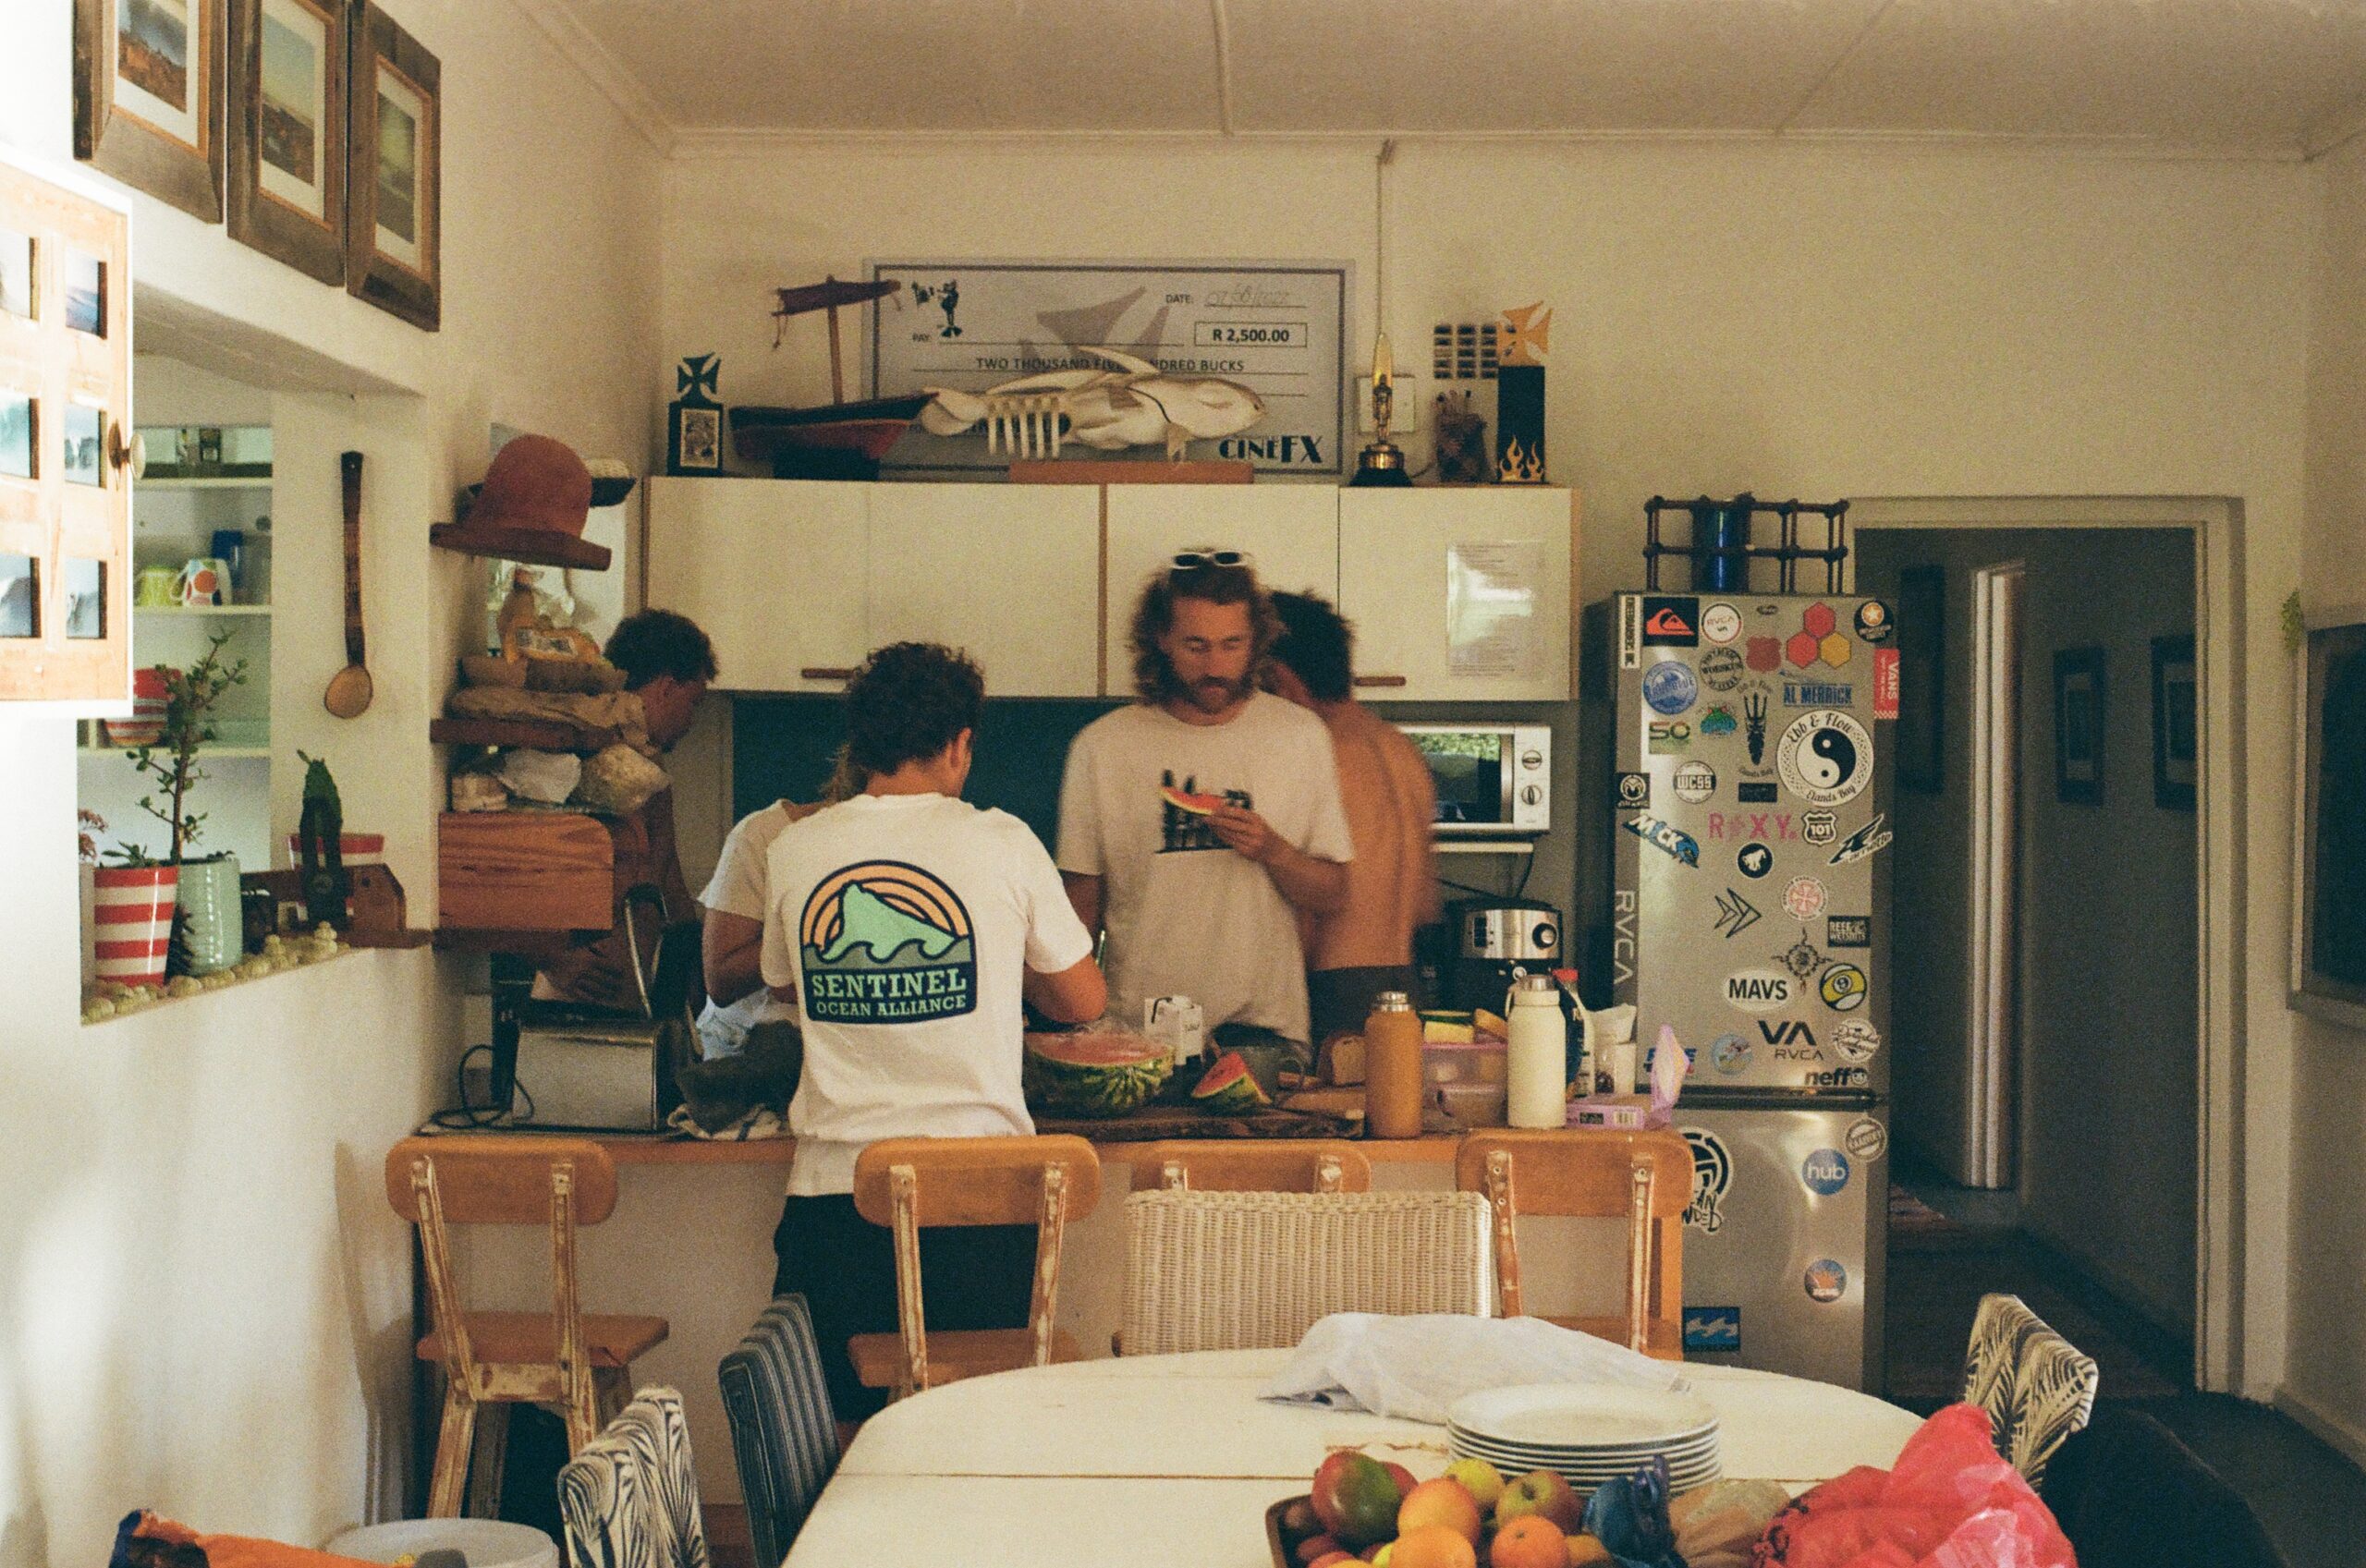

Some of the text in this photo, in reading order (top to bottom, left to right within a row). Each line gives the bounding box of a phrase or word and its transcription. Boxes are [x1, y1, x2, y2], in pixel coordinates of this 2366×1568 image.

[1165, 293, 1194, 304] DATE:
[1212, 328, 1289, 345] R 2,500.00
[976, 358, 1007, 370] TWO
[1014, 358, 1089, 370] THOUSAND
[1201, 359, 1245, 371] BUCKS
[1887, 661, 1899, 700] VANS
[1784, 686, 1796, 704] AL
[1800, 686, 1852, 704] MERRICK
[1787, 722, 1808, 743] Ebb
[1810, 713, 1819, 727] &
[1806, 784, 1856, 802] Elands Bay
[1811, 824, 1830, 835] 101
[1829, 921, 1850, 932] REEF
[1614, 890, 1636, 985] RVCA
[811, 967, 967, 998] SENTINEL
[1728, 978, 1788, 1000] MAVS
[816, 994, 967, 1016] OCEAN ALLIANCE
[1774, 1049, 1824, 1061] RVCA
[1805, 1067, 1850, 1086] neff
[1807, 1162, 1846, 1180] hub
